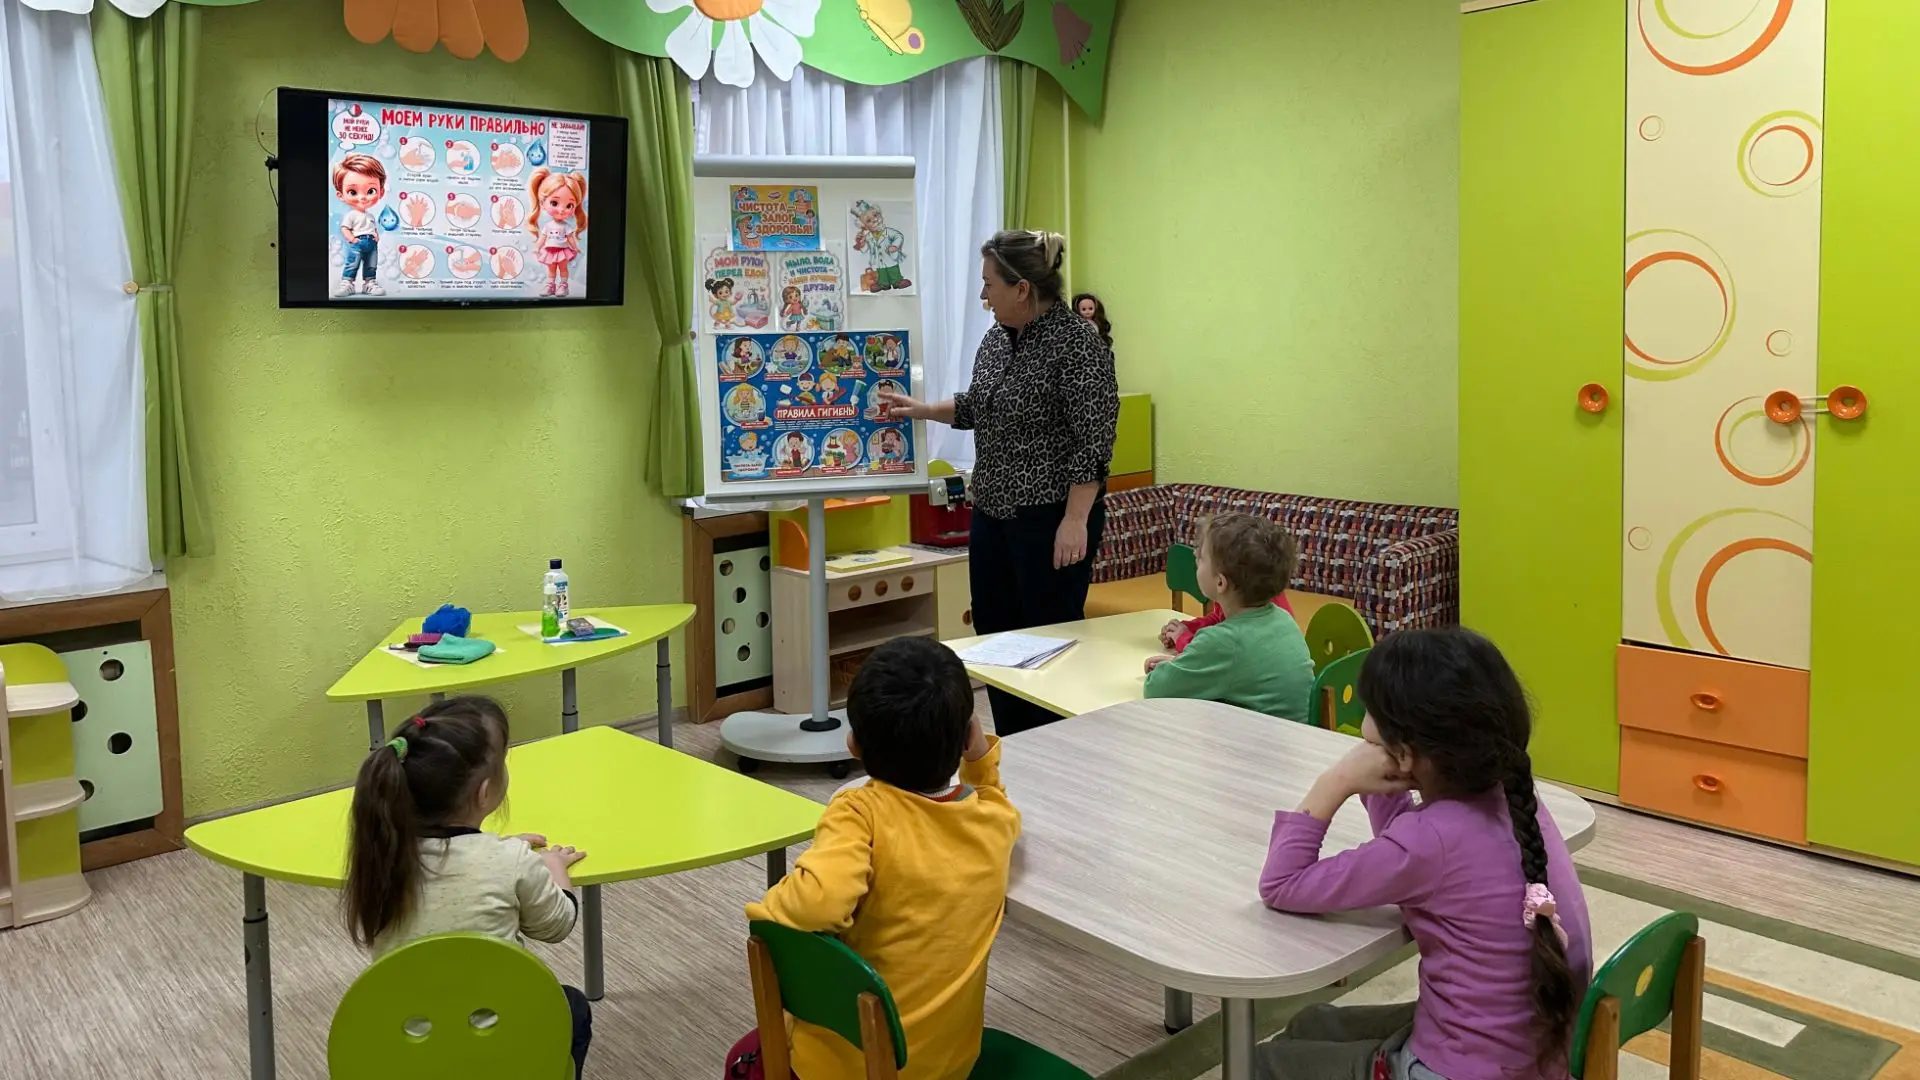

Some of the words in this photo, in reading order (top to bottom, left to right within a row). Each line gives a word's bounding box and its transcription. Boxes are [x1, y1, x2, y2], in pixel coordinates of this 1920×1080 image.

[382, 108, 423, 127] МОЕМ
[428, 113, 464, 130] РУКИ
[470, 115, 546, 136] ПРАВИЛЬНО
[348, 132, 374, 141] СЕКУНД!
[739, 203, 787, 212] ЧИСТОТА
[763, 213, 793, 223] ЗАЛОГ
[755, 224, 812, 235] ЗДОРОВЬЯ!
[714, 254, 739, 267] МОЙ
[741, 256, 764, 267] РУКИ
[813, 256, 834, 265] ВОДА
[714, 268, 743, 278] ПЕРЕД
[796, 266, 828, 274] ЧИСТОТА
[803, 283, 835, 292] ДРУЗЬЯ
[777, 408, 816, 418] ПРАВИЛА
[818, 406, 855, 417] ГИГИЕНЫ
